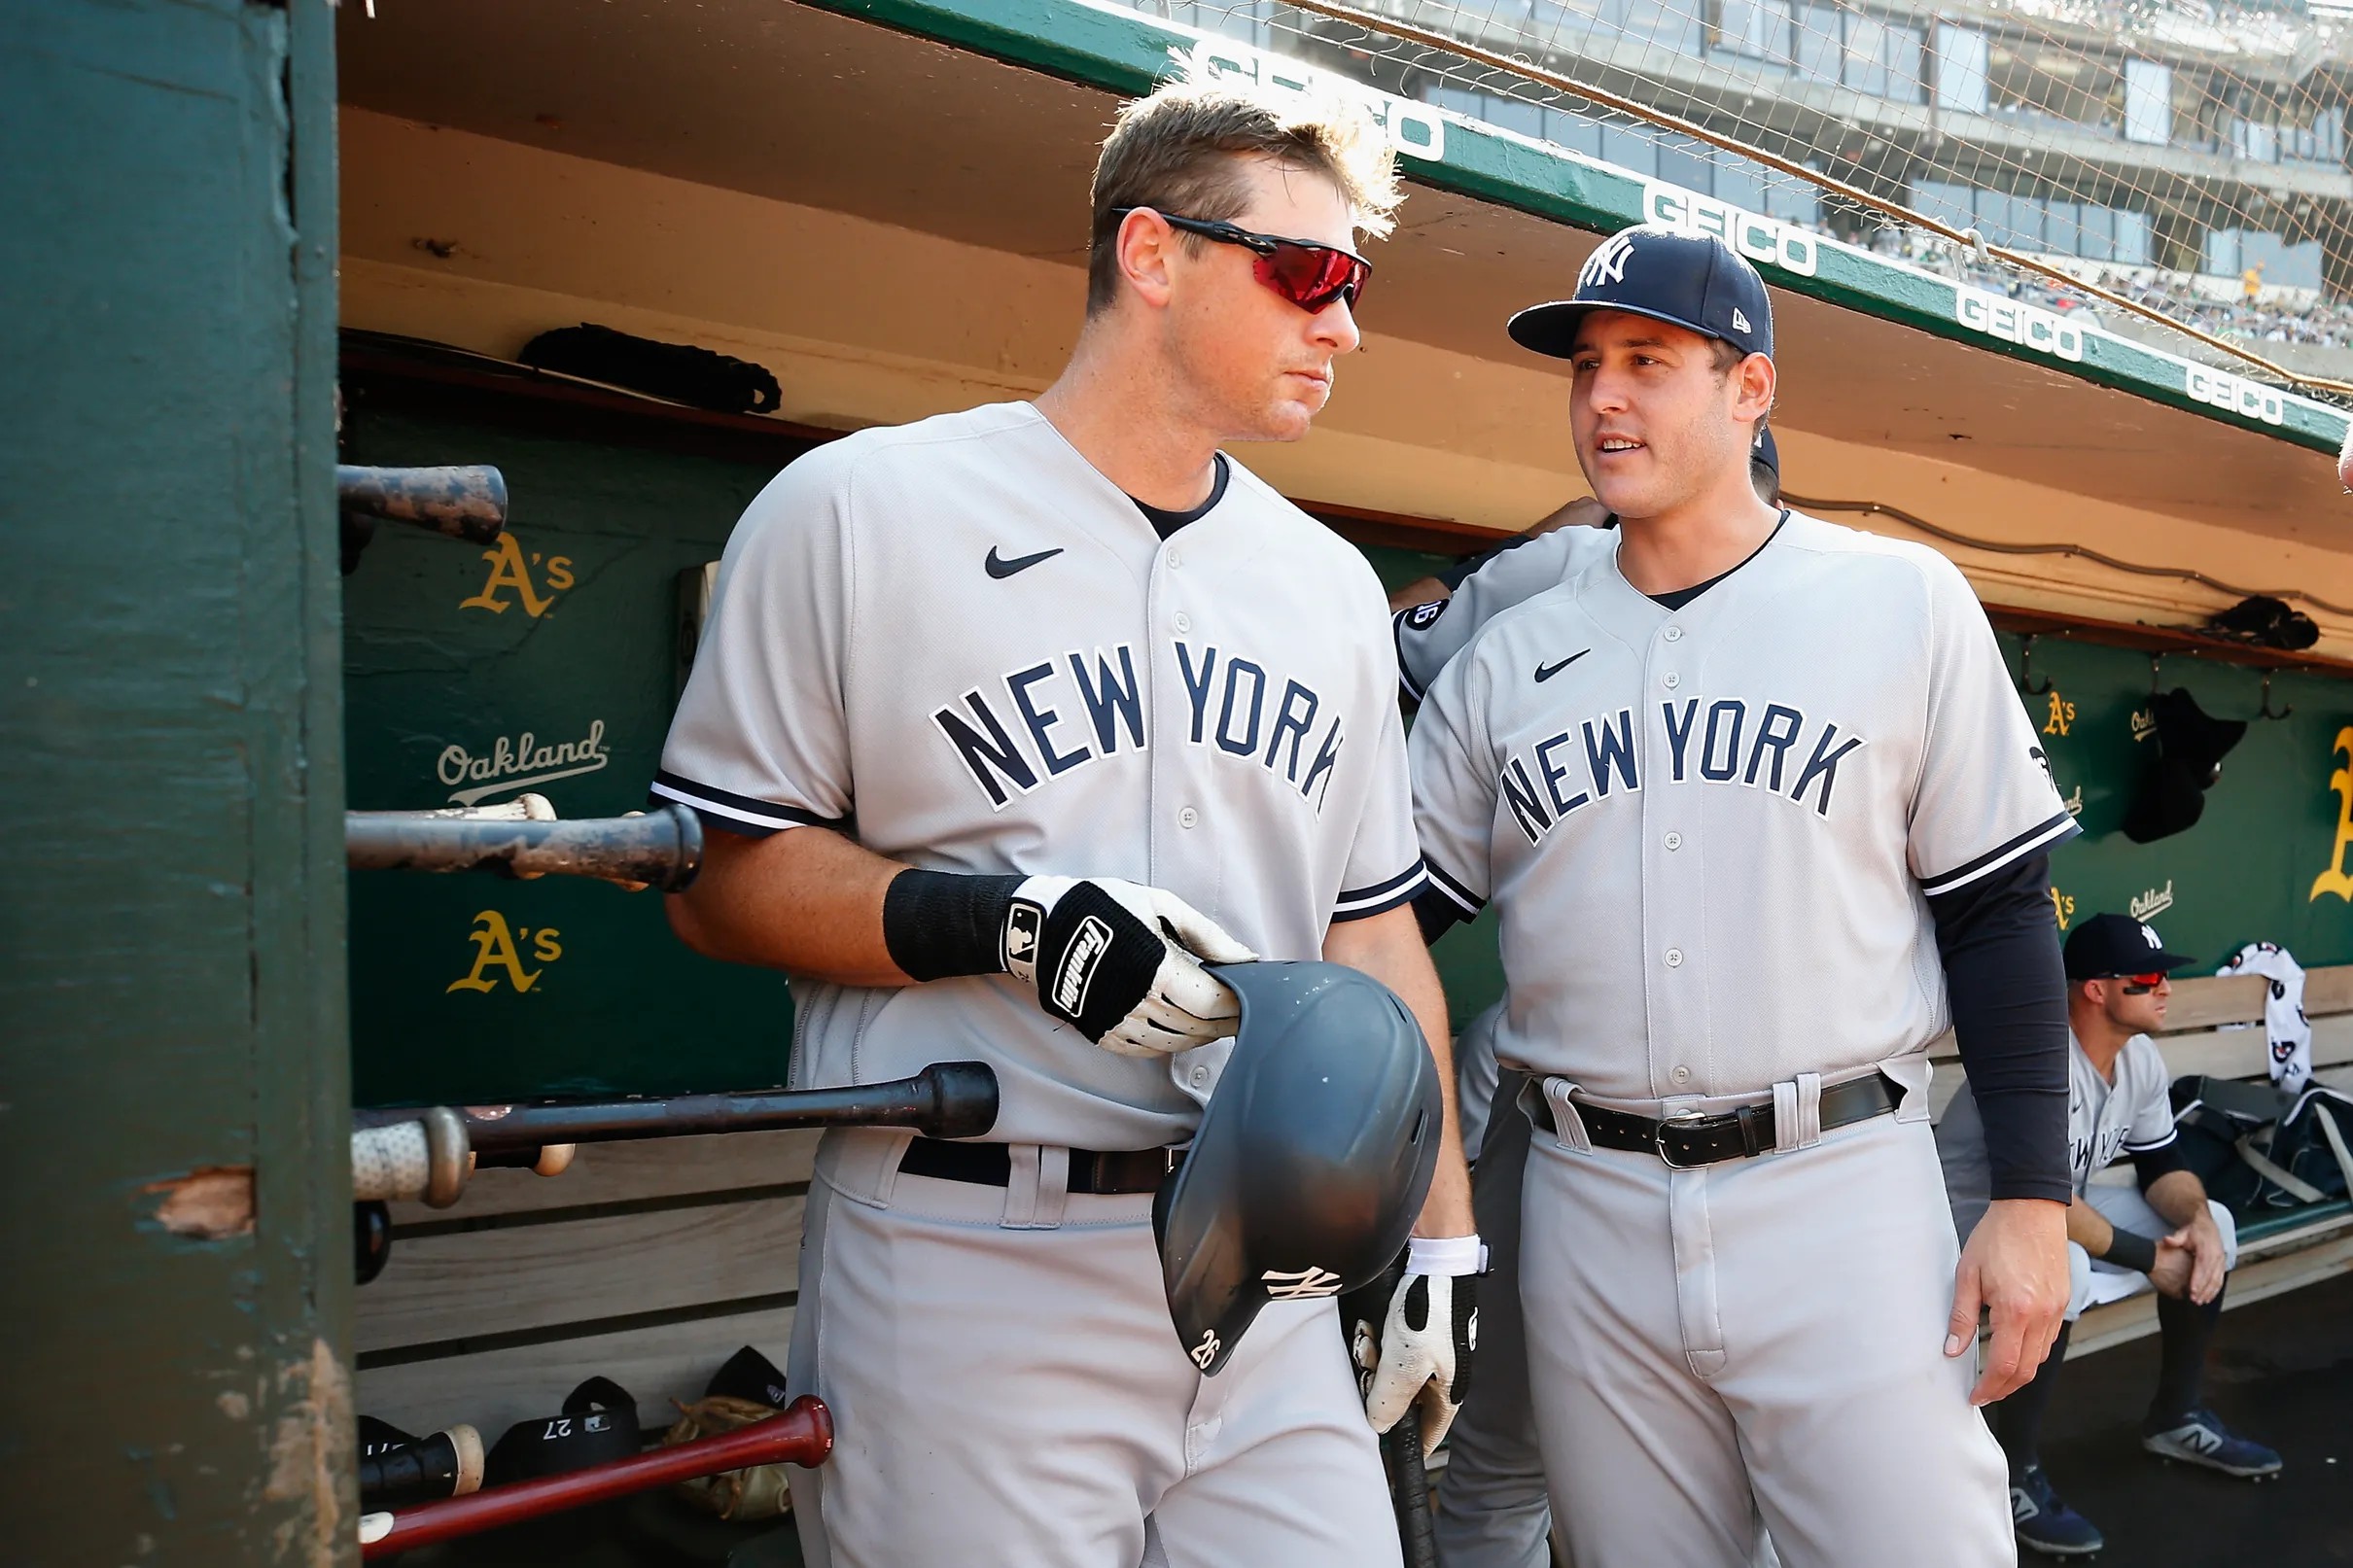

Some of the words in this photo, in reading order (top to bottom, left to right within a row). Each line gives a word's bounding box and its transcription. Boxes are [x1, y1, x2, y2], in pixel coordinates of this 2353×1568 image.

[1643, 182, 1817, 277] GEICO
[1955, 288, 2084, 363] GEICO
[2185, 366, 2283, 426] GEICO
[459, 531, 576, 617] A's
[929, 641, 1149, 813] NEW
[2043, 691, 2076, 736] A's
[438, 719, 607, 786] Oakland
[1499, 705, 1642, 848] NEW
[1659, 694, 1869, 822] YORK
[2130, 879, 2173, 919] Oakland
[446, 910, 562, 993] A's
[1060, 920, 1105, 1010] Franklin
[1191, 1329, 1221, 1370] 26
[544, 1418, 572, 1441] 27
